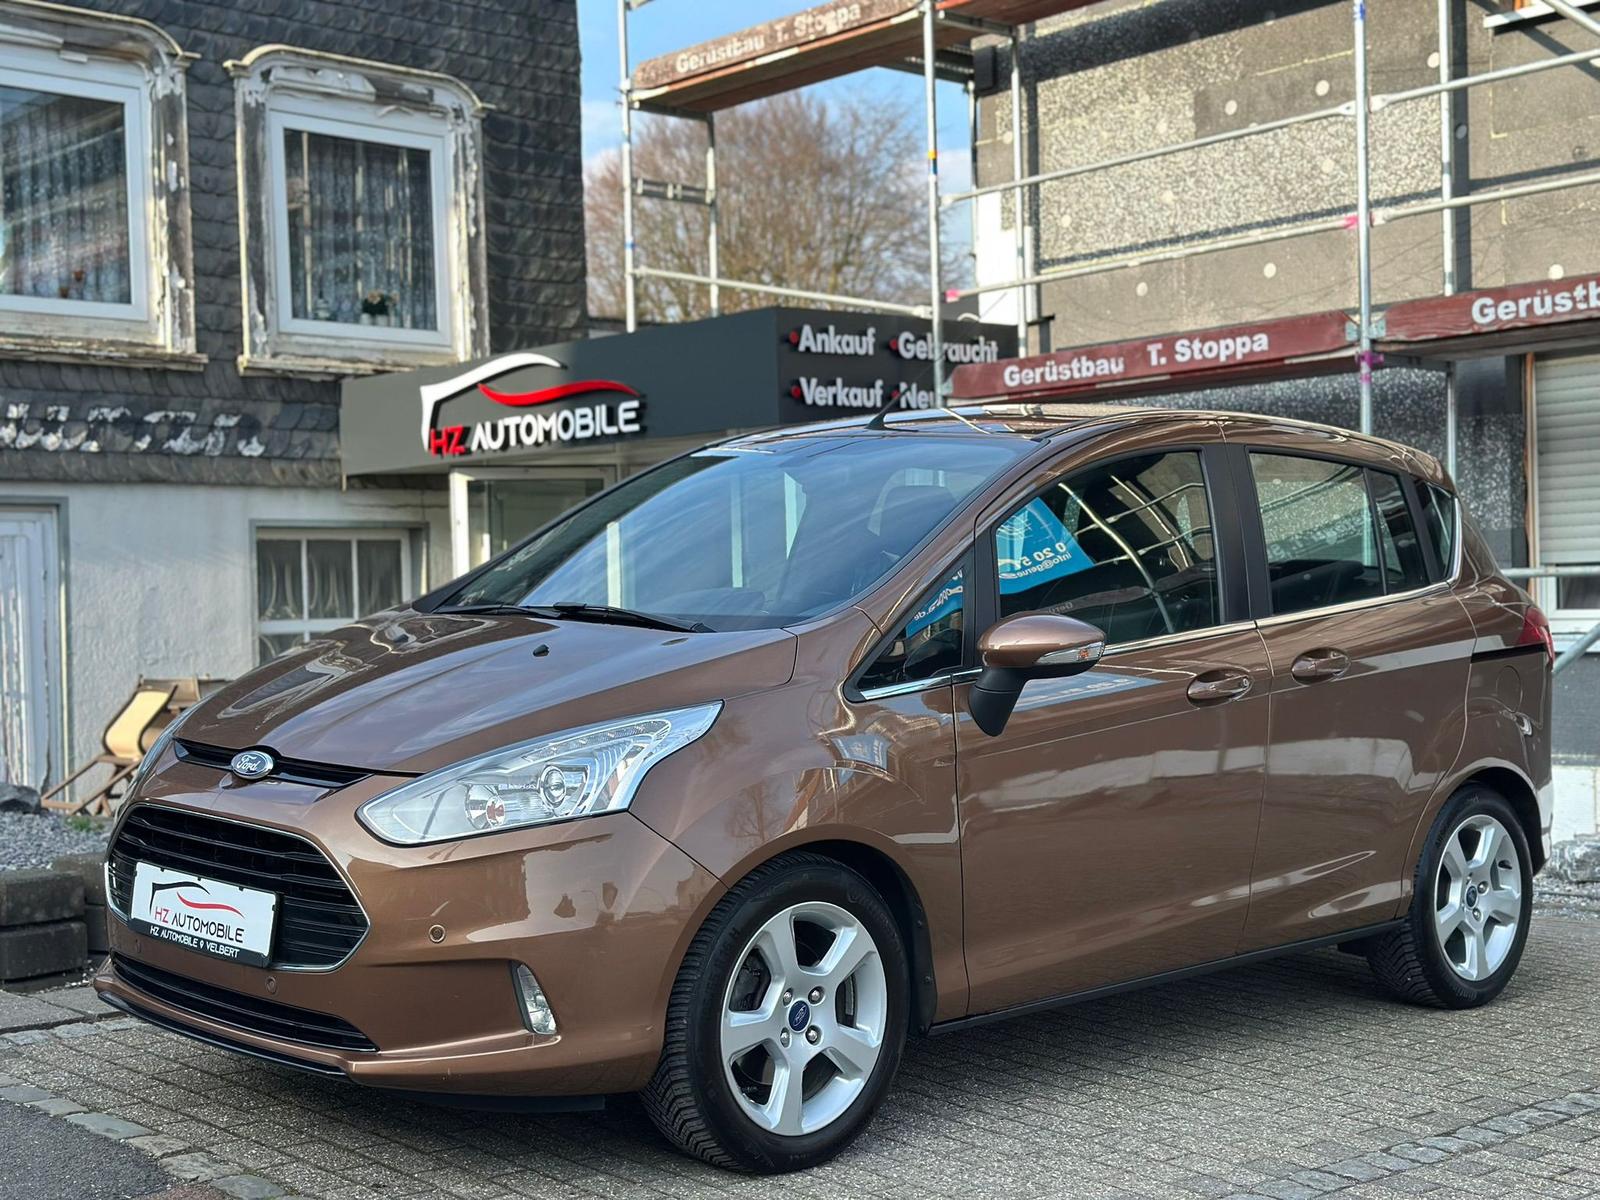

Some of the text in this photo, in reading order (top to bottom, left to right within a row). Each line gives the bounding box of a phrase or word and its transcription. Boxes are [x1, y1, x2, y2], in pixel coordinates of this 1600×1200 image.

[774, 22, 790, 43] T.
[800, 324, 876, 356] Ankauf
[1003, 333, 1269, 387] Gerüstbau T. Stoppa
[799, 376, 883, 408] Verkauf
[430, 400, 641, 456] HZ AUTOMOBILE
[236, 754, 261, 771] Ford
[154, 906, 245, 944] HZ AUTOMOBILE
[150, 925, 241, 958] HZ AUTOMOBILE VELBERT
